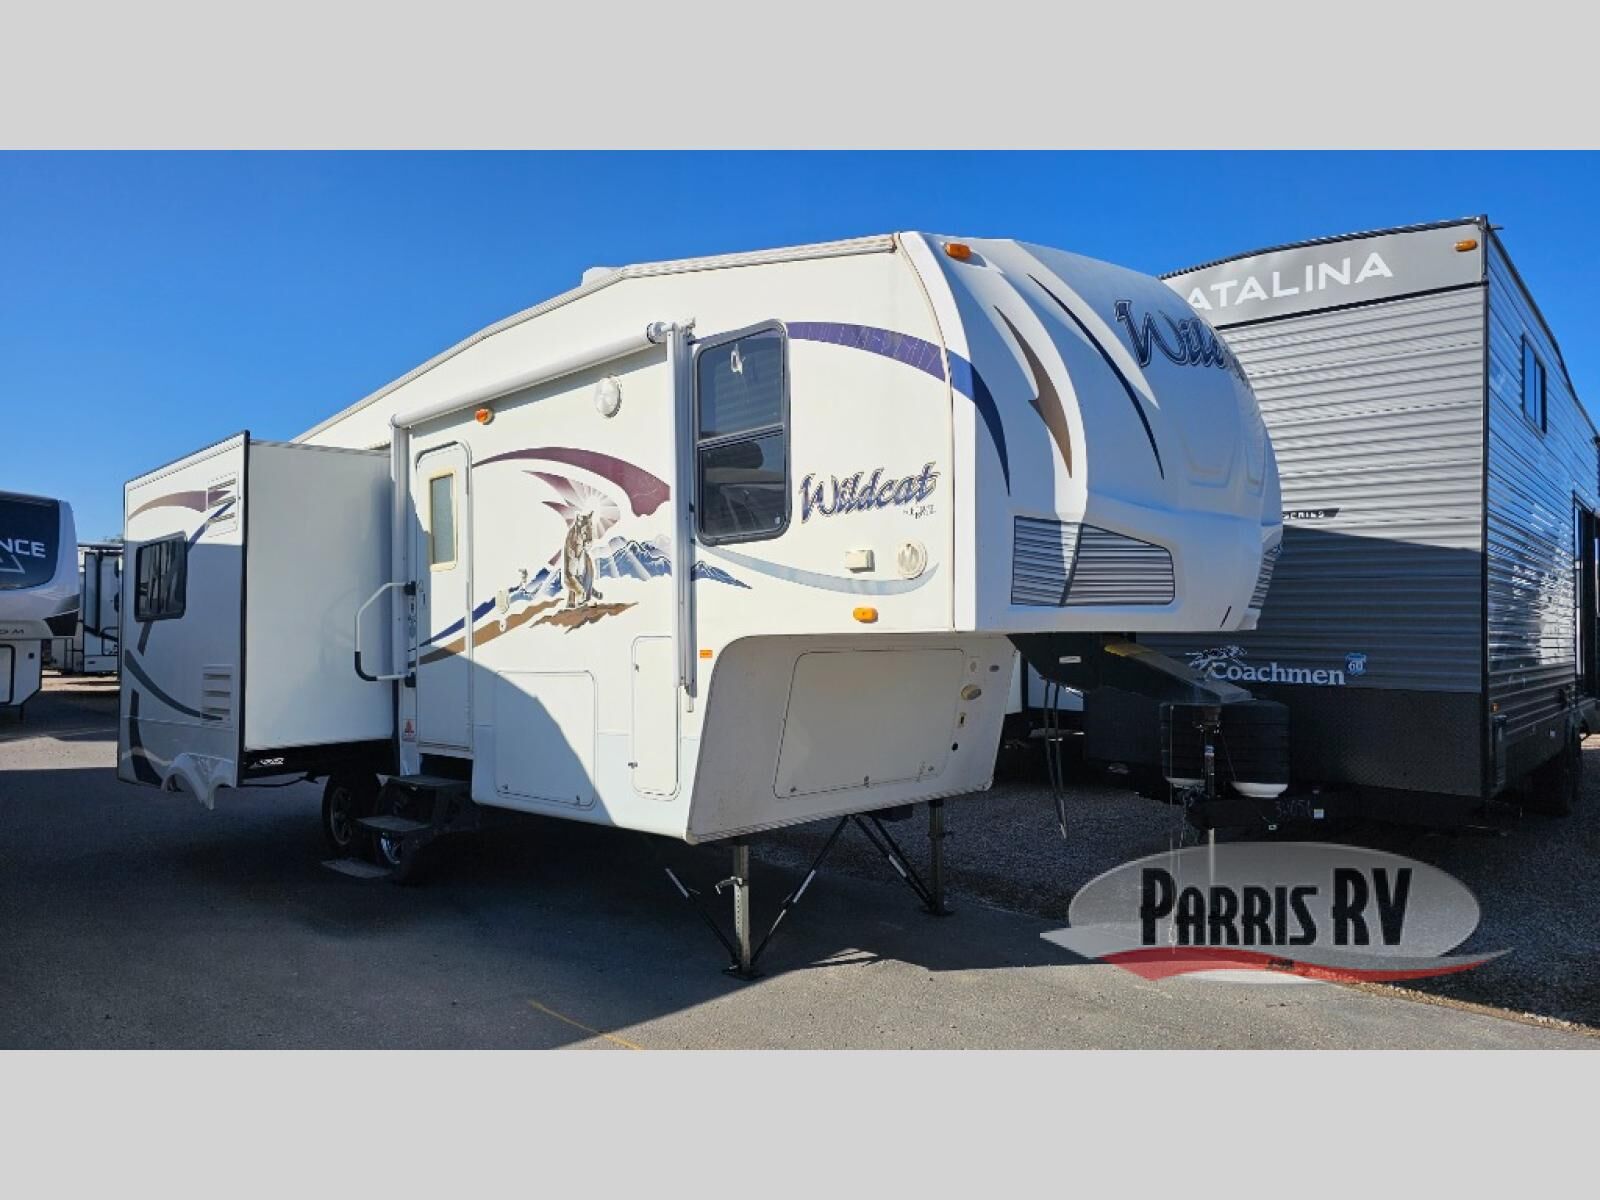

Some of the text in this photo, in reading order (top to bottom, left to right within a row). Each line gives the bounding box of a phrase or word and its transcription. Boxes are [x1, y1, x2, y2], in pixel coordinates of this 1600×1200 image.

[1187, 252, 1393, 311] ATALINA
[799, 461, 941, 524] Wildcat
[1211, 661, 1346, 685] Coachmen
